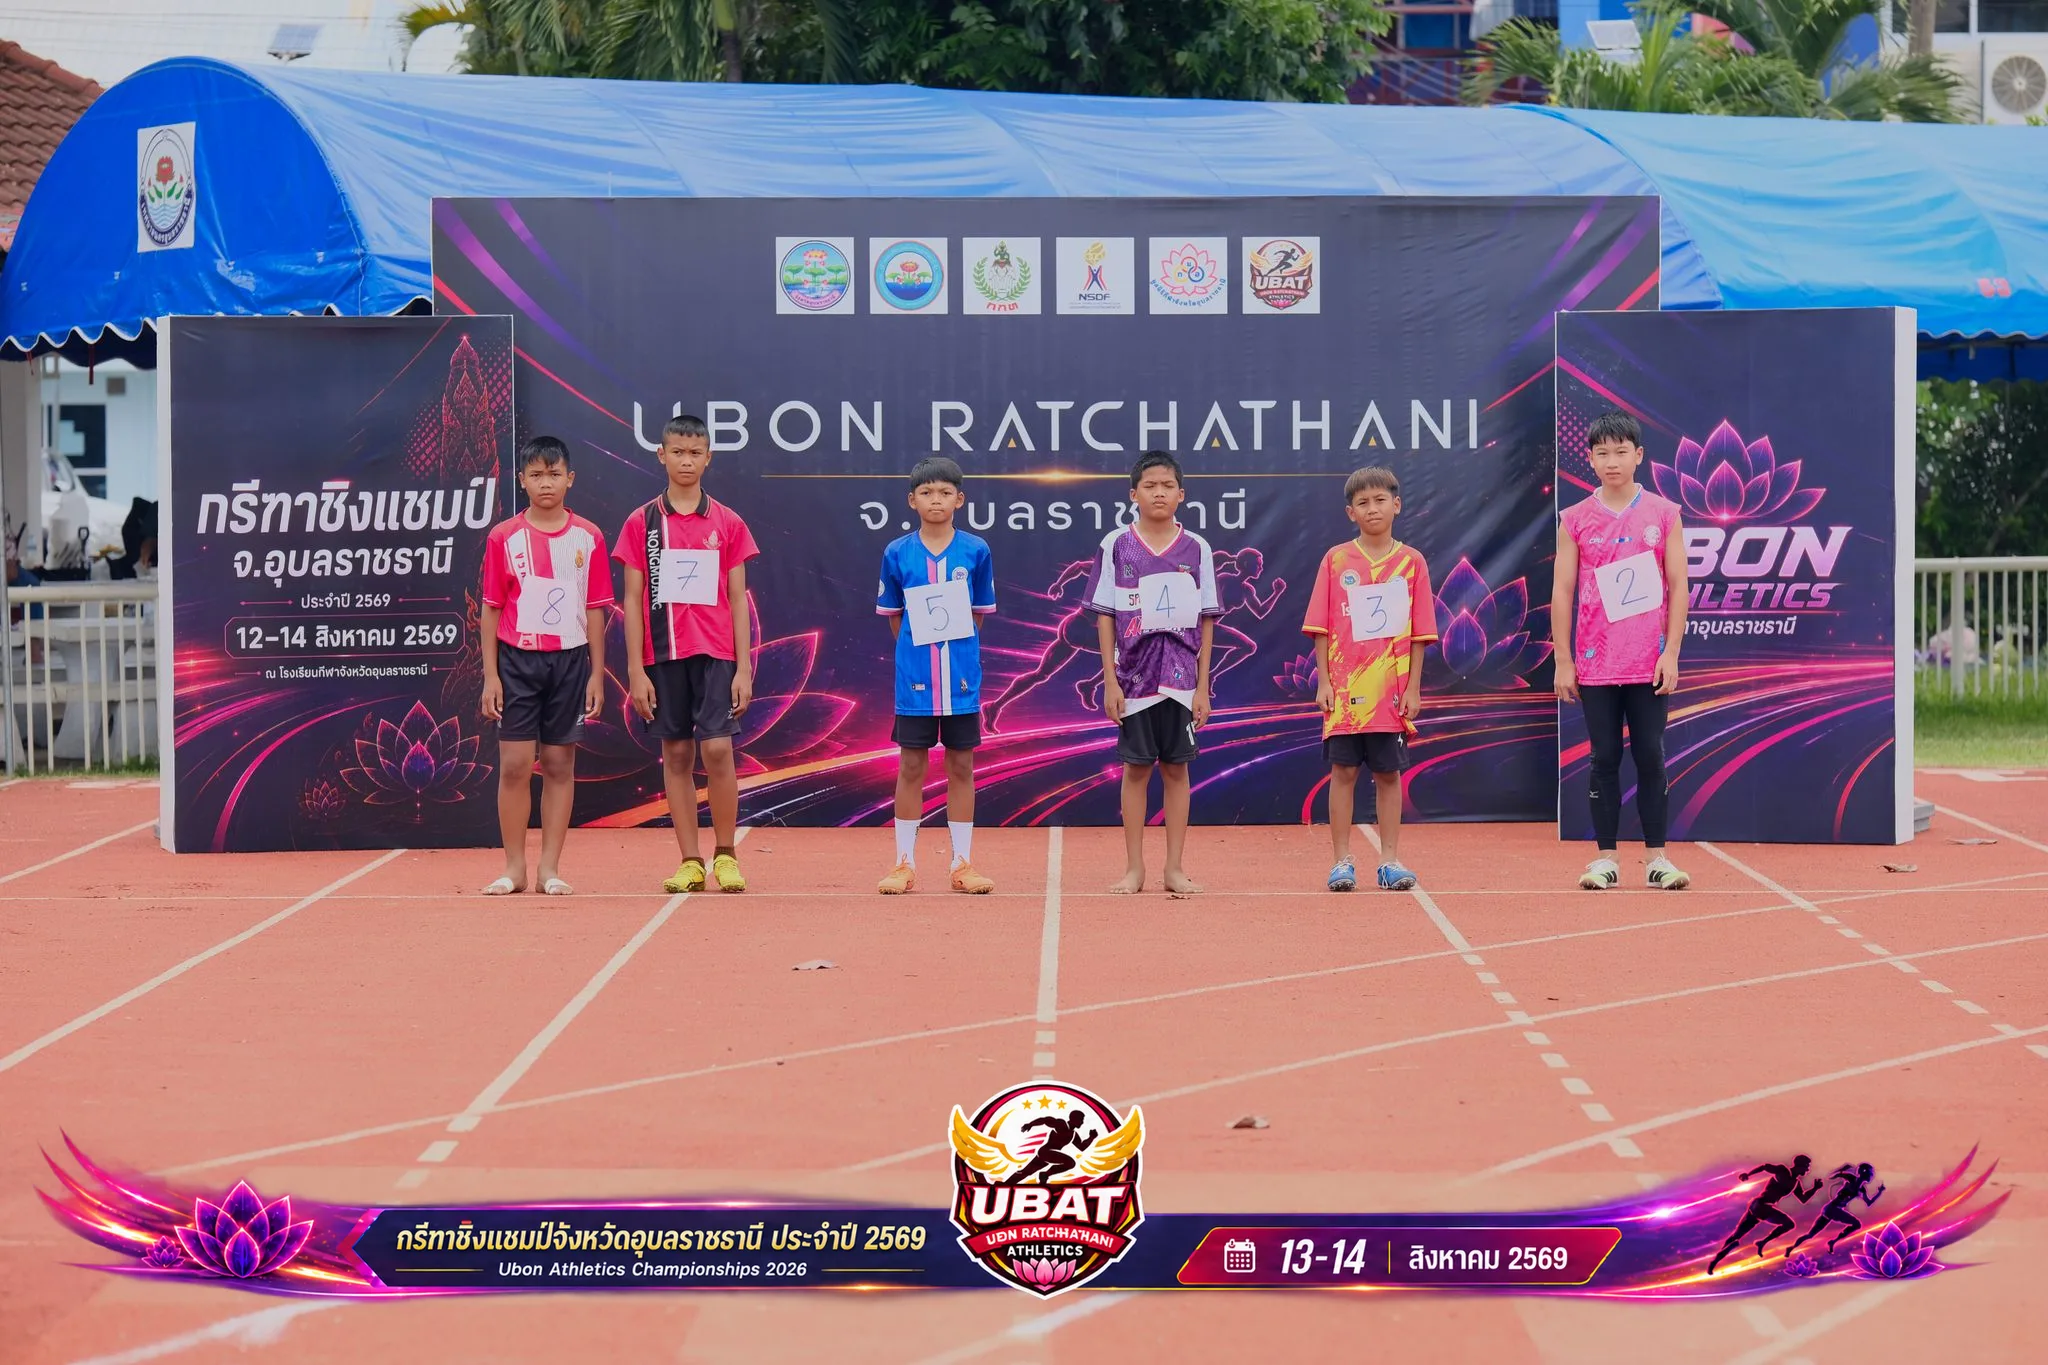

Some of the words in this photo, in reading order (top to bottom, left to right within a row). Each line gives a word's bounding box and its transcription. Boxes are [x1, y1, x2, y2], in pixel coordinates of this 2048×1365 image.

[1078, 293, 1111, 301] NSDF
[1255, 276, 1308, 289] UBAT
[986, 302, 1019, 312] กกท
[633, 400, 883, 453] UBON
[931, 399, 1478, 452] RATCHATHANI
[197, 477, 497, 534] กรีฑาชิงแชมป์
[859, 488, 1246, 531] จ.บลราชานี
[233, 537, 454, 588] จ.อุบลราชธานี
[1683, 526, 1853, 577] BON
[676, 560, 698, 592] 7
[1615, 567, 1649, 606] 2
[301, 593, 350, 609] ประจำปี
[355, 593, 391, 608] 2569
[541, 587, 565, 625] 8
[925, 594, 950, 631] 5
[1155, 584, 1176, 618] 4
[1365, 595, 1388, 634] 3
[315, 625, 395, 648] สิงหาคม
[404, 624, 458, 646] 2569
[265, 670, 276, 679] ณ
[279, 664, 428, 680] โรงเรียนกีฬาจังหวัดอุบลราชธานี
